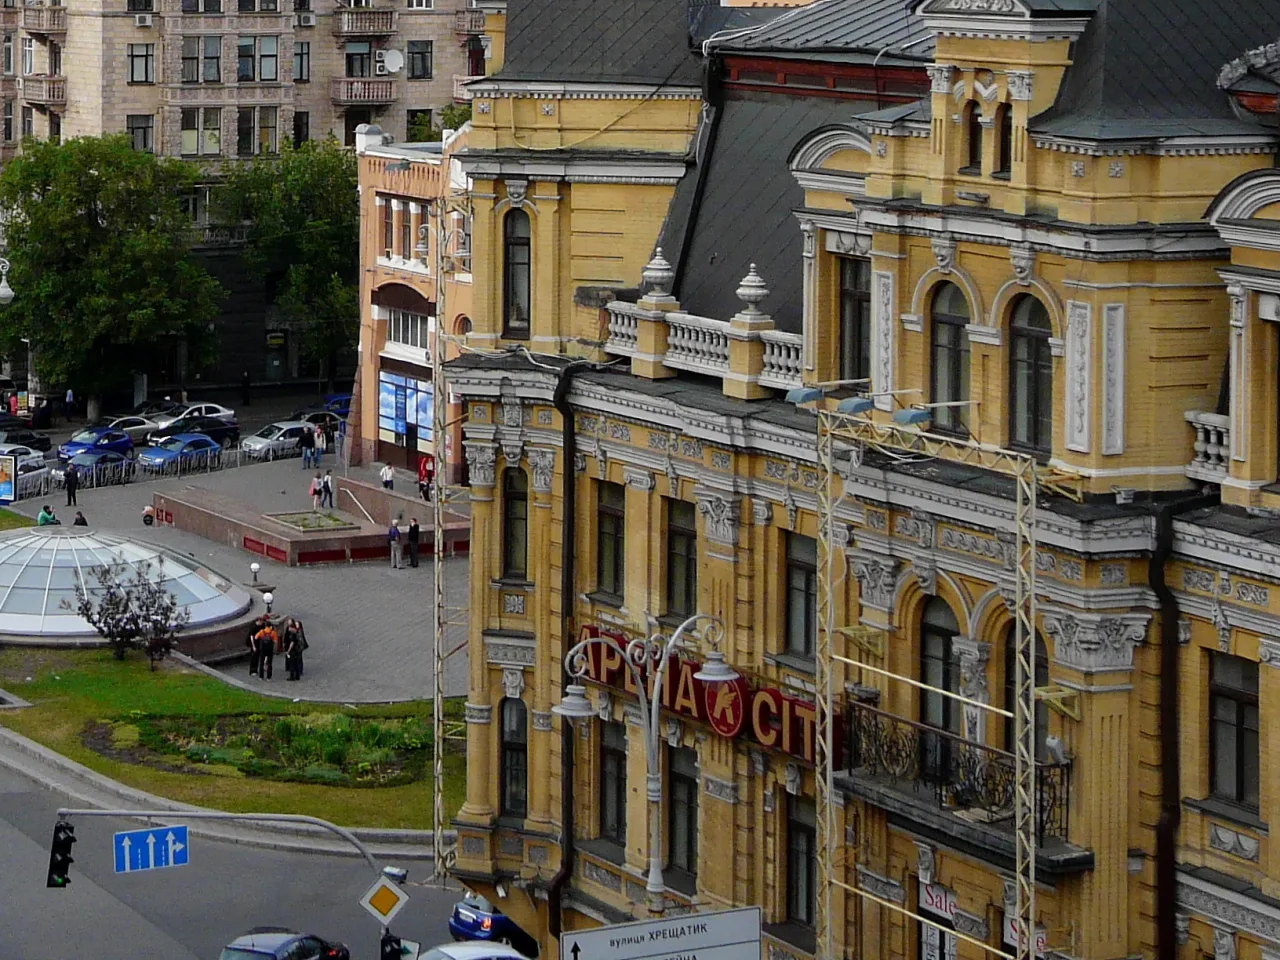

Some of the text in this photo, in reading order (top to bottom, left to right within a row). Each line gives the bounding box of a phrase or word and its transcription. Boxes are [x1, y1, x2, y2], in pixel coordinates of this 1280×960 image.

[752, 691, 841, 768] CIT
[925, 883, 957, 915] Sale
[609, 923, 708, 948] вулиця ХРЕЩАТИК
